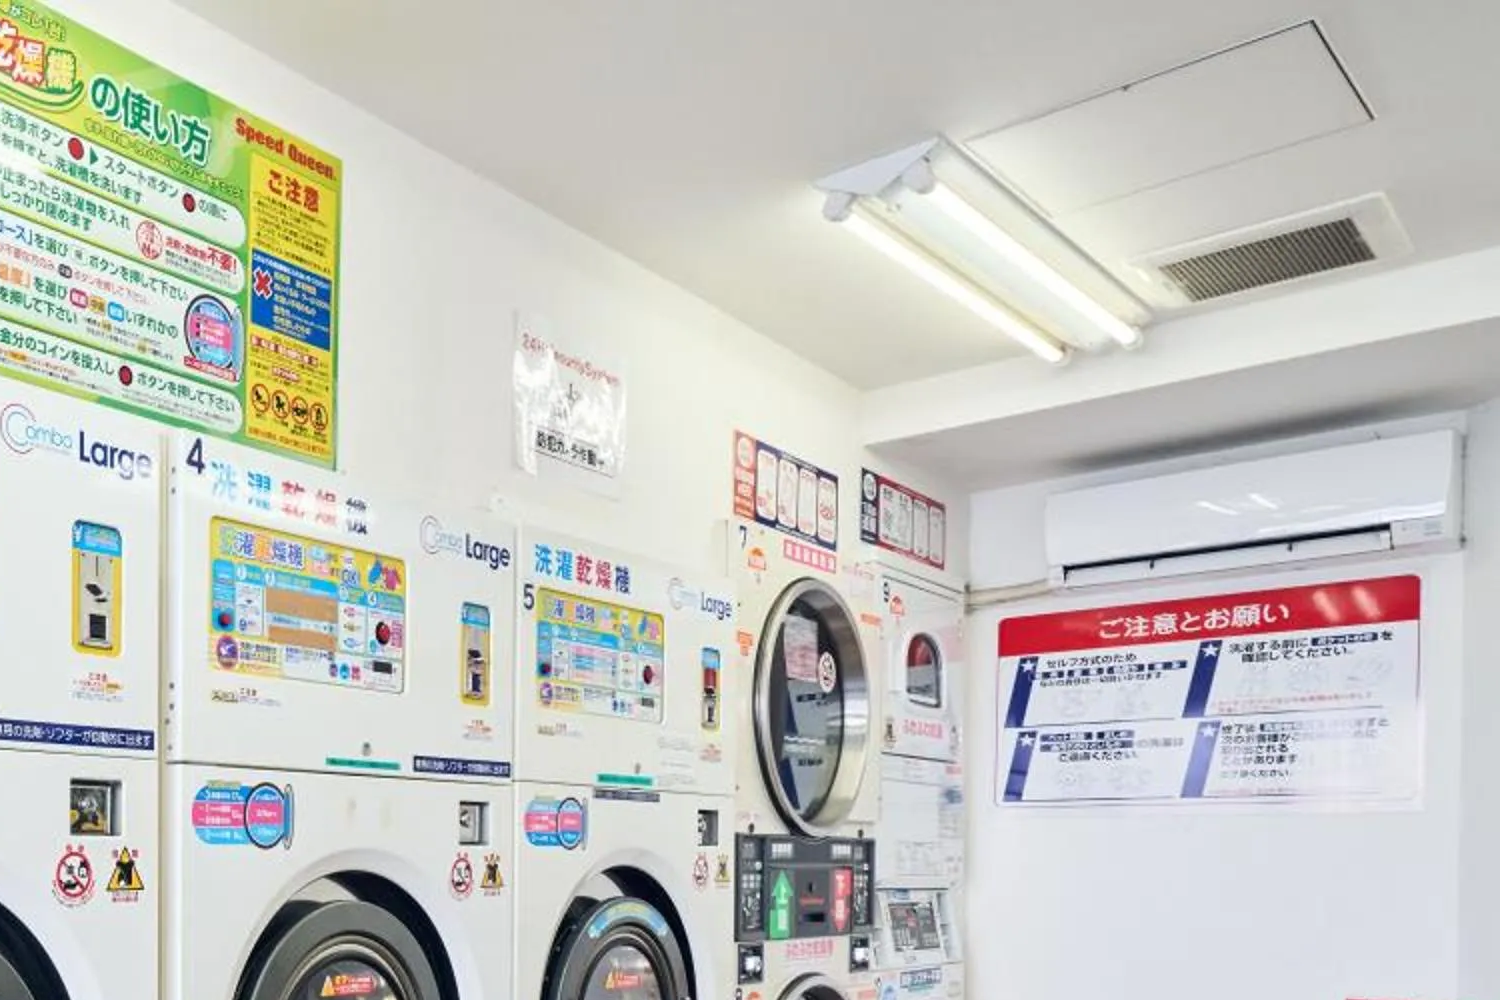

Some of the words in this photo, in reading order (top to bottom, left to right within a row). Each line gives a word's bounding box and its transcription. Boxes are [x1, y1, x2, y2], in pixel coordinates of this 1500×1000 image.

[91, 77, 210, 163] の使い方
[235, 118, 284, 156] Speed
[288, 144, 336, 181] Queen
[104, 155, 179, 198] スタートボタン
[268, 170, 320, 214] ご注意
[126, 311, 179, 339] いずれかの
[137, 372, 235, 412] ボタンを押して下さい
[80, 429, 152, 480] Large
[186, 437, 205, 475] 4
[464, 533, 511, 569] Large
[535, 544, 630, 594] 洗濯乾燥機
[523, 583, 535, 610] 5
[1099, 602, 1290, 640] ご注意とお願い
[1046, 653, 1137, 669] セルフ方式のため
